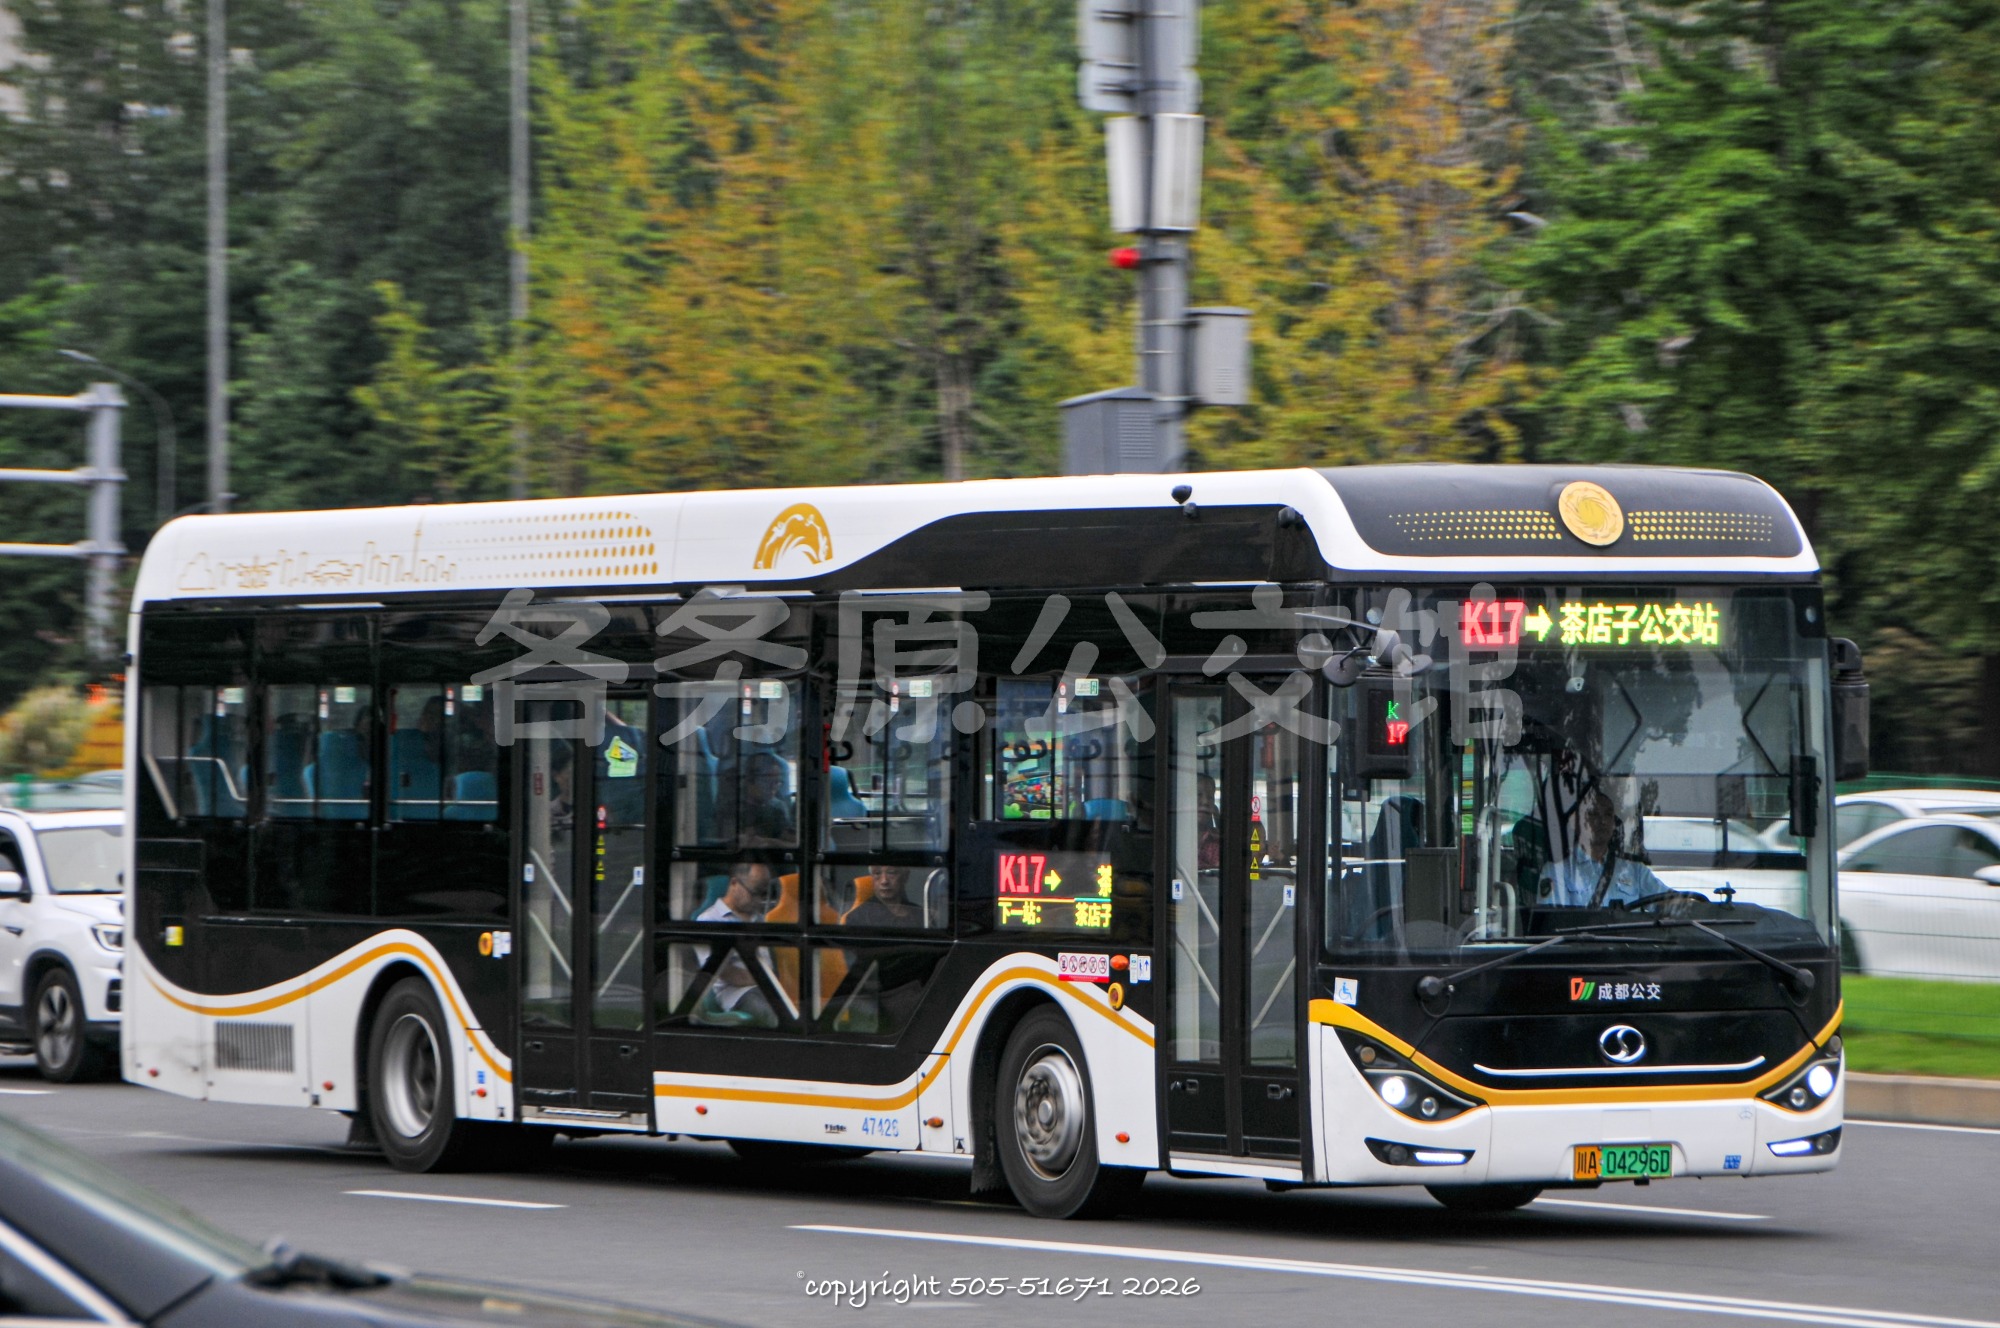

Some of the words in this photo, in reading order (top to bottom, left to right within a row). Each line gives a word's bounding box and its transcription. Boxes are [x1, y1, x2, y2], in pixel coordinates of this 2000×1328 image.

[1462, 601, 1525, 645] K17
[1559, 602, 1720, 645] 茶店子公交站
[1387, 722, 1409, 745] 17
[999, 854, 1046, 894] K17
[1097, 864, 1113, 897] 茶
[1075, 903, 1113, 928] 茶店子
[1598, 982, 1661, 1000] 成都公交
[1606, 1149, 1670, 1174] 04296D
